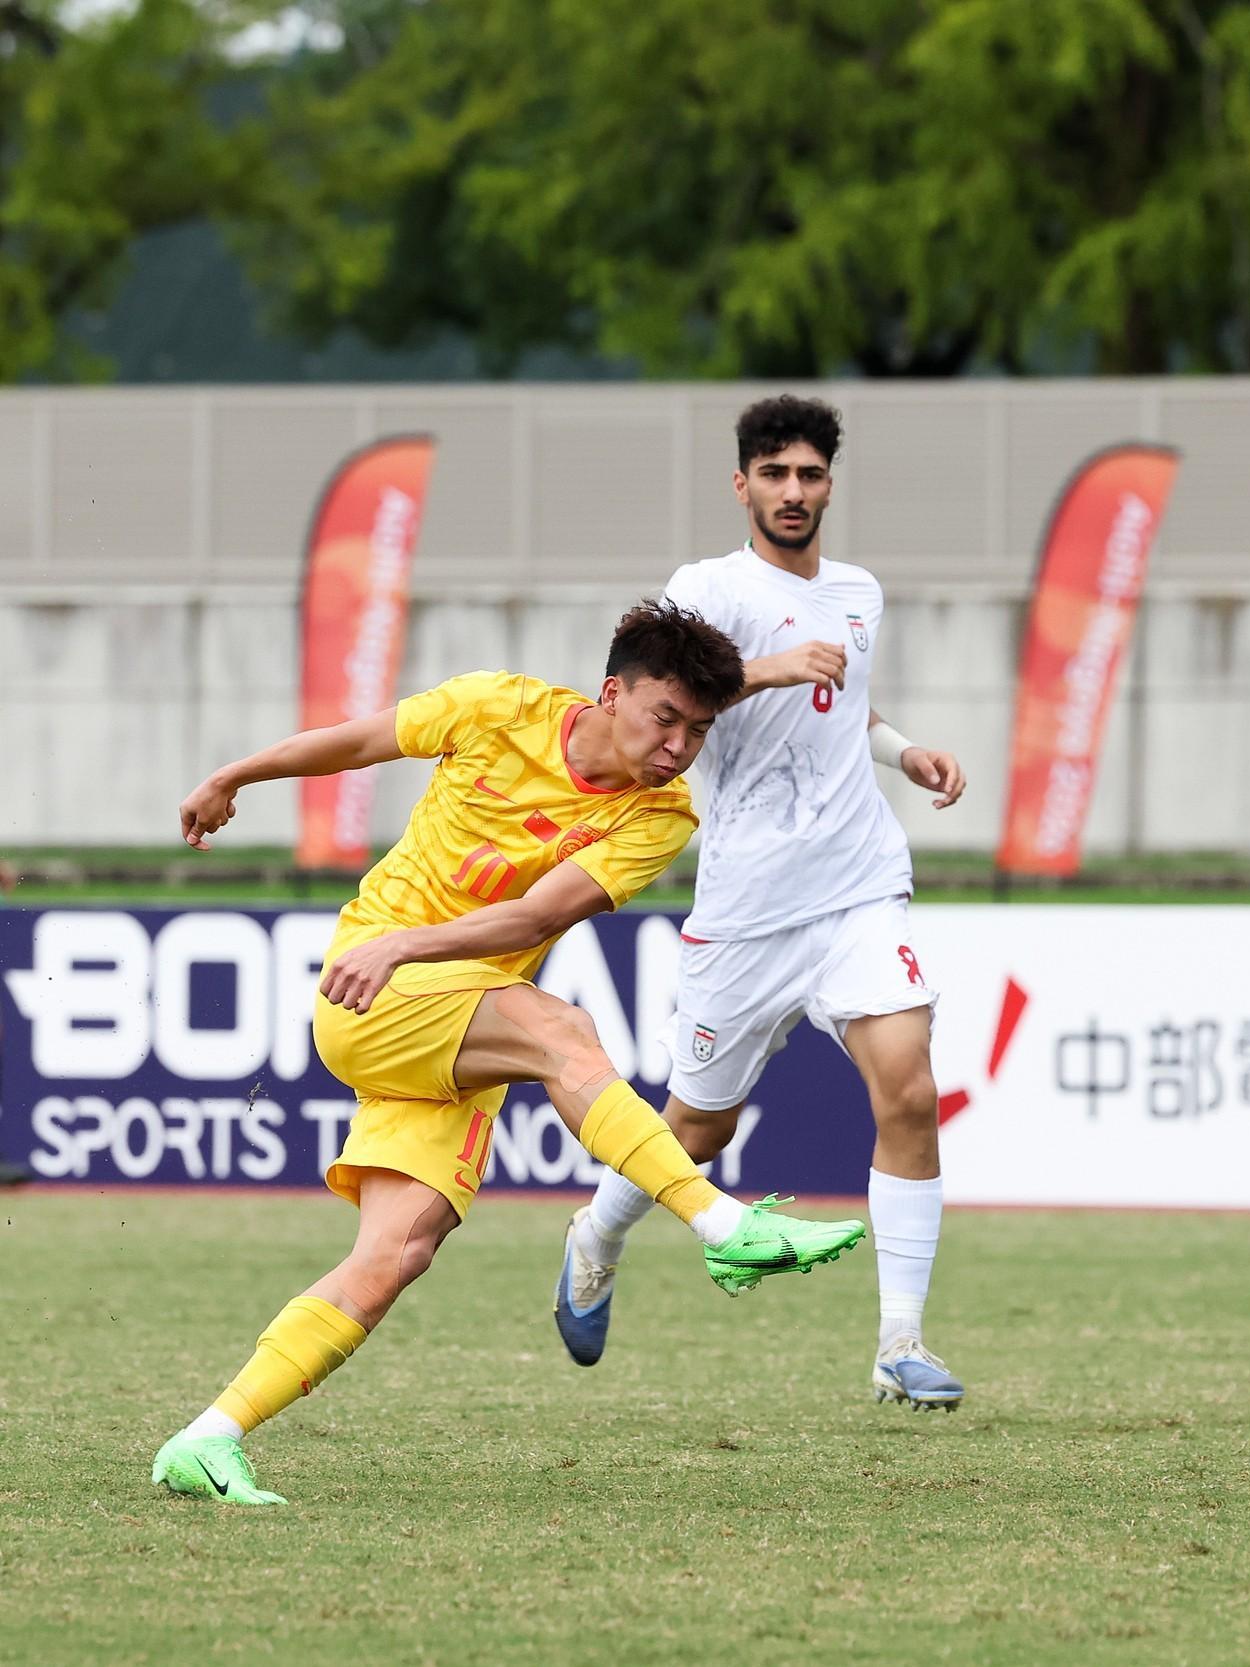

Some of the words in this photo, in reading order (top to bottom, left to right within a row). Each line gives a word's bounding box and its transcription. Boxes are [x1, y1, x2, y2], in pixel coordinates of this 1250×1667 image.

[450, 840, 518, 904] 10
[30, 1097, 287, 1180] SPORTS
[456, 1108, 493, 1180] 1
